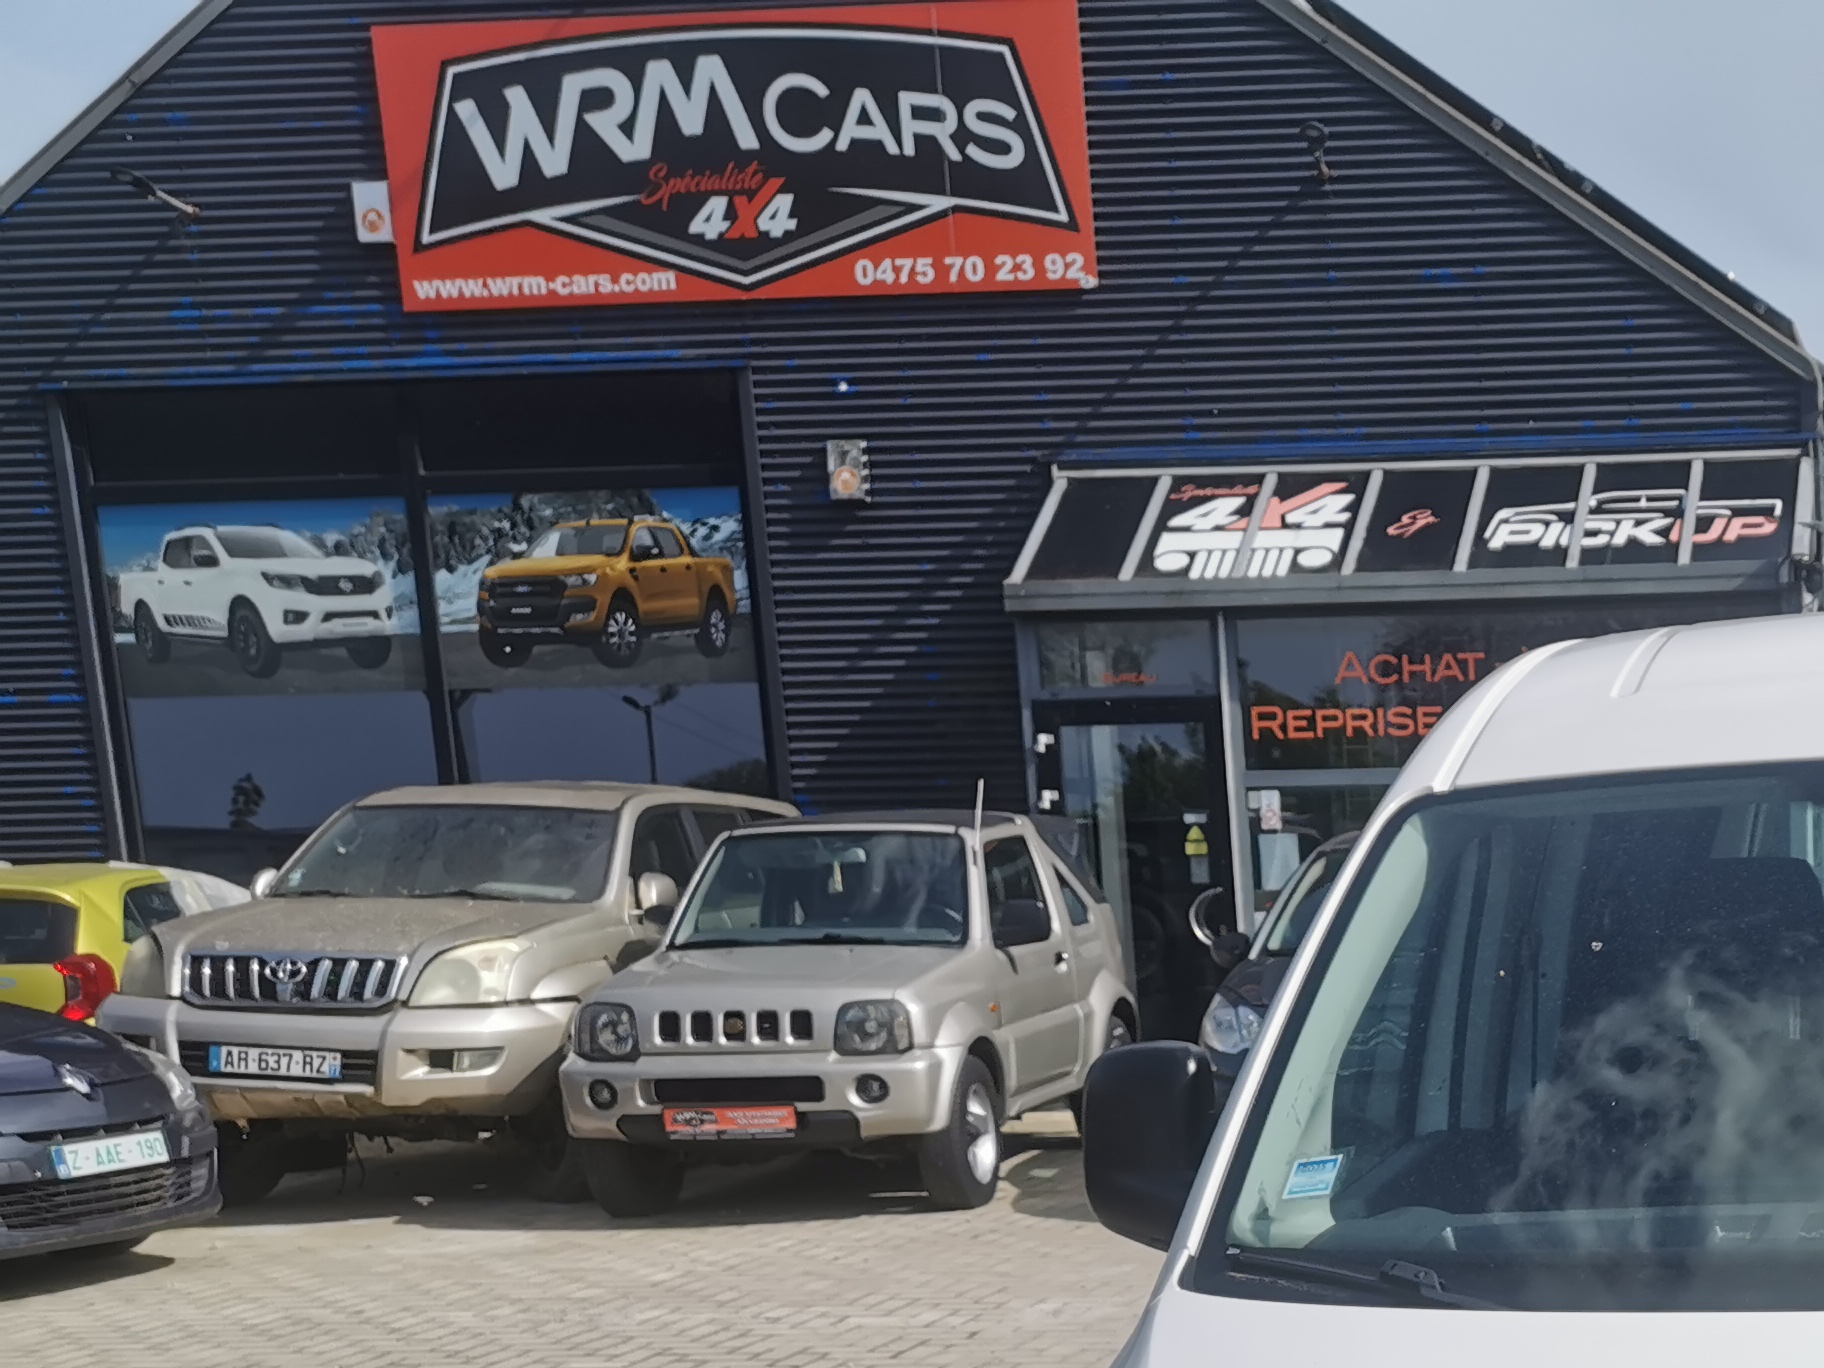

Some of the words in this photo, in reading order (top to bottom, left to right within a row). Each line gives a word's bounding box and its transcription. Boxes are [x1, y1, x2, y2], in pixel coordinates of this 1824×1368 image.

[412, 270, 678, 300] www.wrm-cars.com
[854, 257, 936, 286] 0475
[943, 255, 985, 283] 70
[994, 253, 1035, 282] 23
[1043, 252, 1086, 280] 92
[1334, 651, 1486, 685] ACHAT
